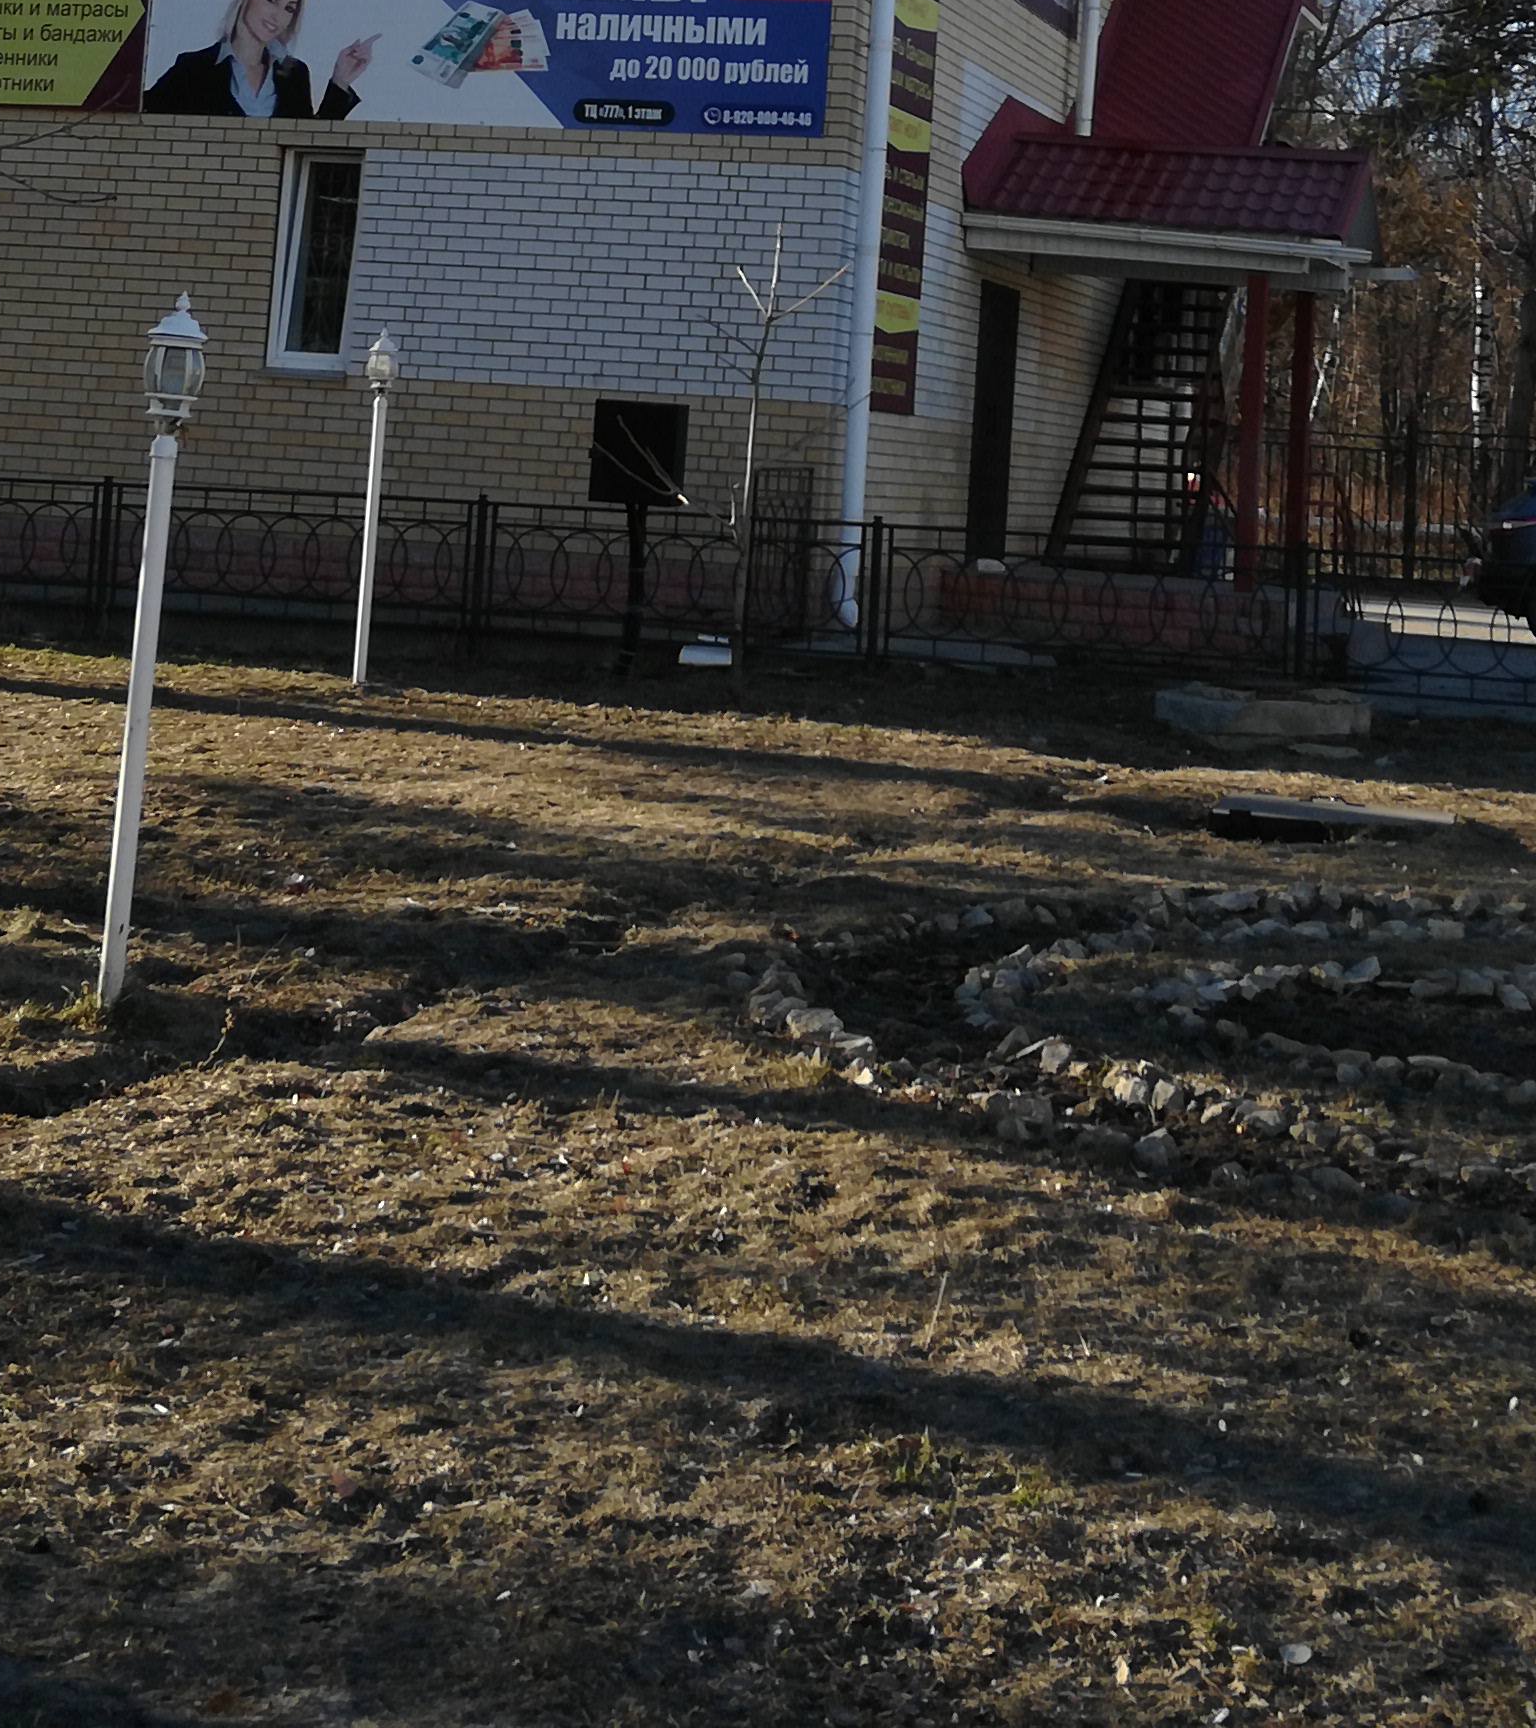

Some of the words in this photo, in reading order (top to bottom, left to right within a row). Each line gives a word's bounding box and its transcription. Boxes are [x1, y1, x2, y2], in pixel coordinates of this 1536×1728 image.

[29, 2, 40, 16] и
[47, 3, 129, 21] матрасы
[23, 28, 34, 40] и
[40, 24, 123, 44] бандажи
[556, 12, 767, 46] наличными
[609, 58, 639, 81] до
[645, 56, 673, 80] 20
[677, 57, 720, 81] 000
[724, 58, 809, 84] рублей
[584, 104, 598, 120] ТЦ
